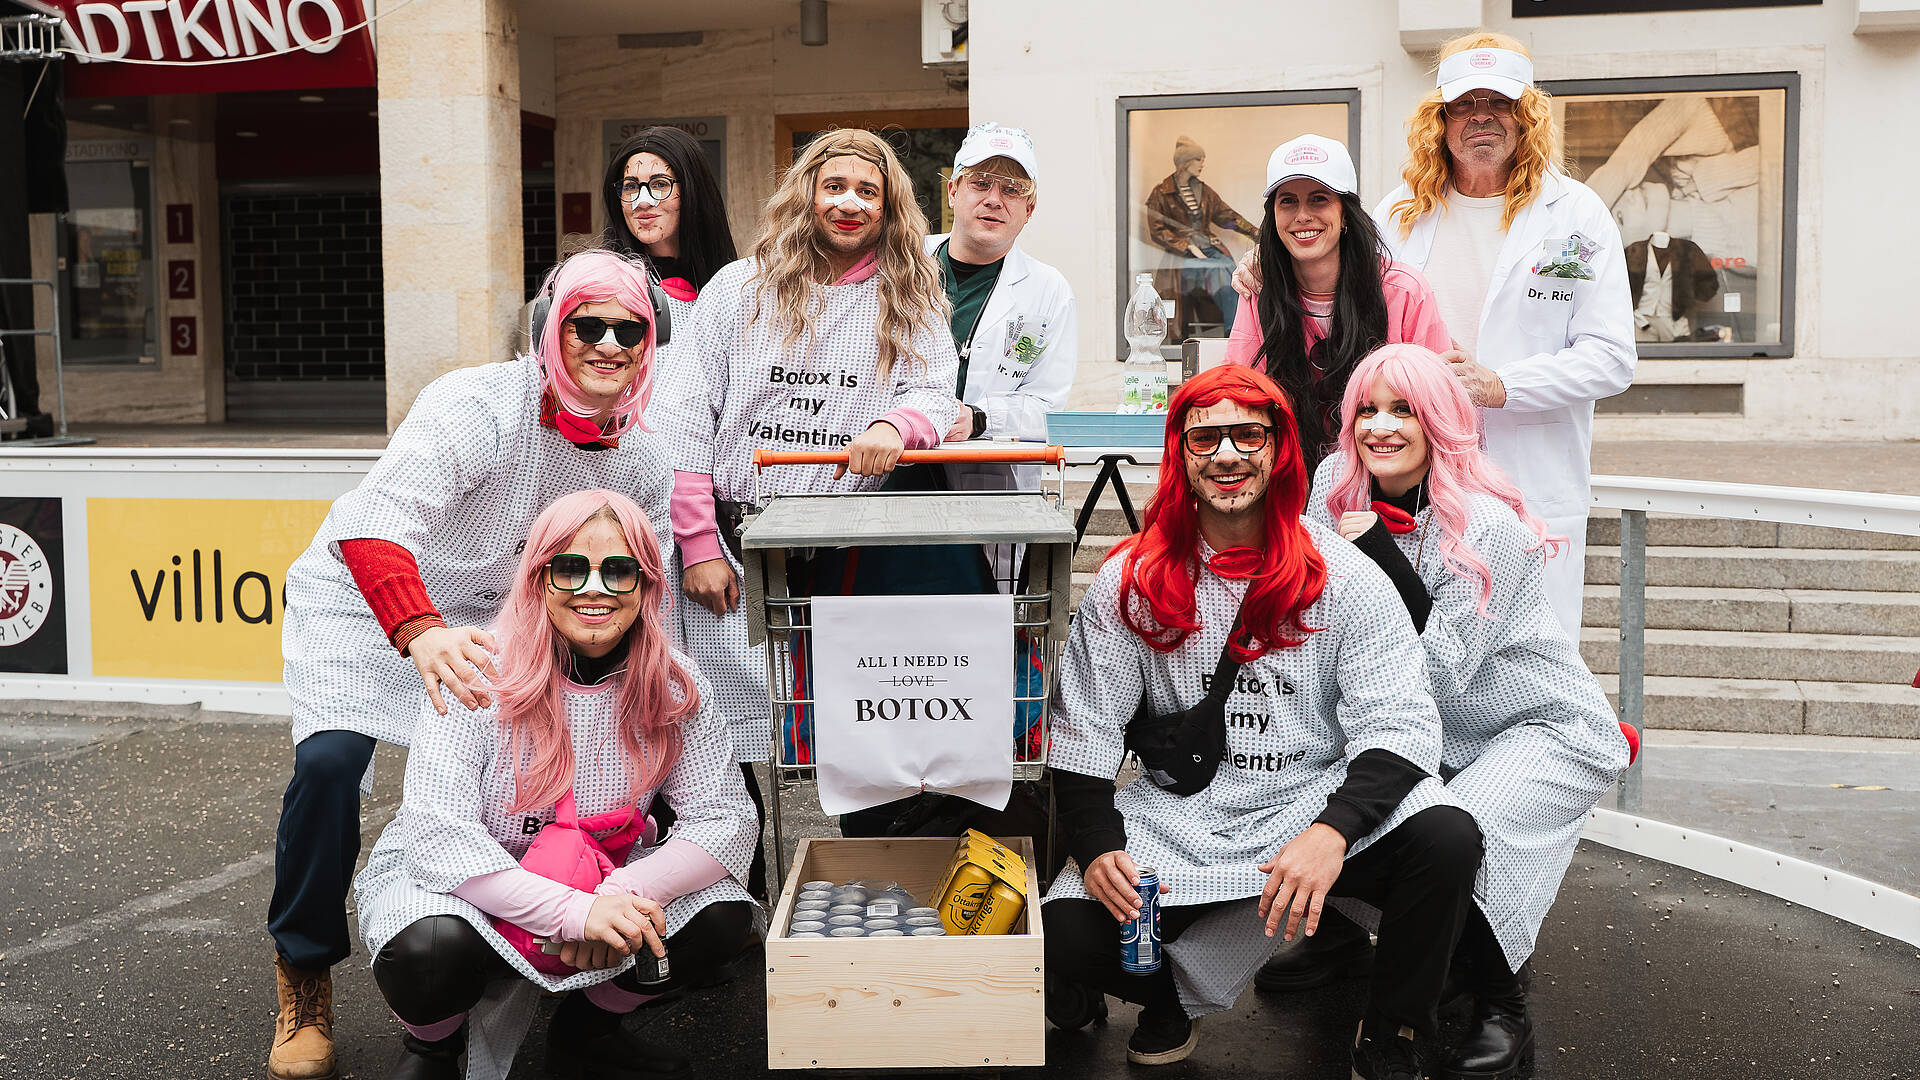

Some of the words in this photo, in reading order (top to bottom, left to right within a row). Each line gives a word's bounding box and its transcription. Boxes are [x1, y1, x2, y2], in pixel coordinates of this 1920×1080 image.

[175, 211, 184, 237] 1
[174, 267, 190, 293] 2
[1527, 287, 1547, 300] Dr.
[176, 323, 191, 349] 3
[769, 365, 832, 386] Botox
[839, 369, 859, 388] is
[789, 396, 826, 416] my
[748, 420, 853, 448] Valentine
[130, 548, 288, 625] villa
[857, 656, 888, 668] ALL
[892, 656, 898, 667] I
[903, 655, 948, 667] NEED
[953, 655, 969, 667] IS
[892, 675, 935, 687] LOVE
[1275, 675, 1297, 696] is
[854, 697, 974, 722] BOTOX
[1229, 711, 1271, 734] my
[1220, 746, 1307, 772] alentine
